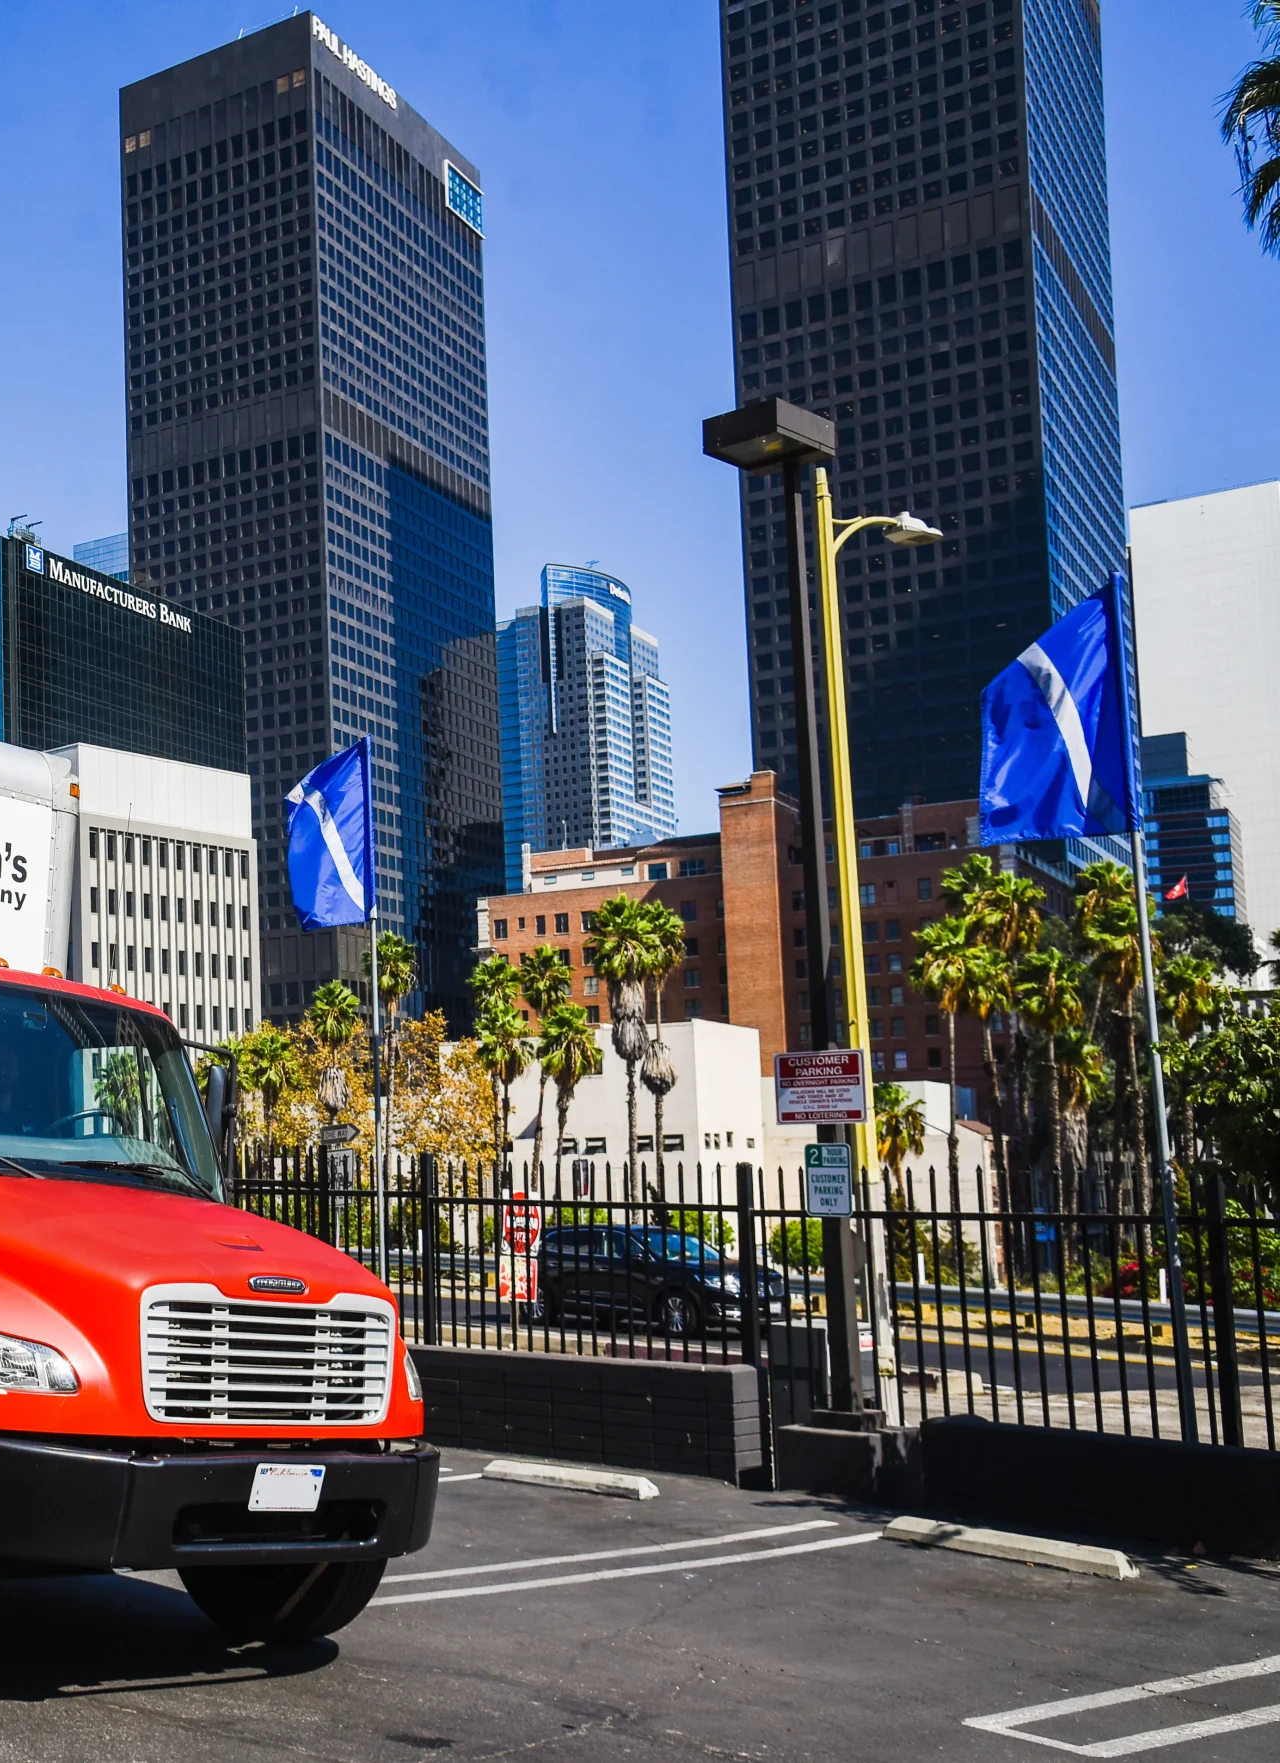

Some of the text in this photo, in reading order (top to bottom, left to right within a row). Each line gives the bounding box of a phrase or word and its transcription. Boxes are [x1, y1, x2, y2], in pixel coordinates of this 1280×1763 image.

[312, 15, 398, 110] PAUL HASTINGS
[788, 1055, 849, 1067] CUSTOMER
[795, 1066, 843, 1077] PARKING
[793, 1079, 828, 1087] OVERNIGHT
[830, 1077, 858, 1085] PARKING
[794, 1111, 848, 1120] NO LOITERING
[809, 1148, 820, 1165] 2
[823, 1156, 847, 1165] PARKING
[811, 1174, 846, 1184] CUSTOMER
[814, 1185, 844, 1195] PARKING
[820, 1197, 838, 1207] ONLY
